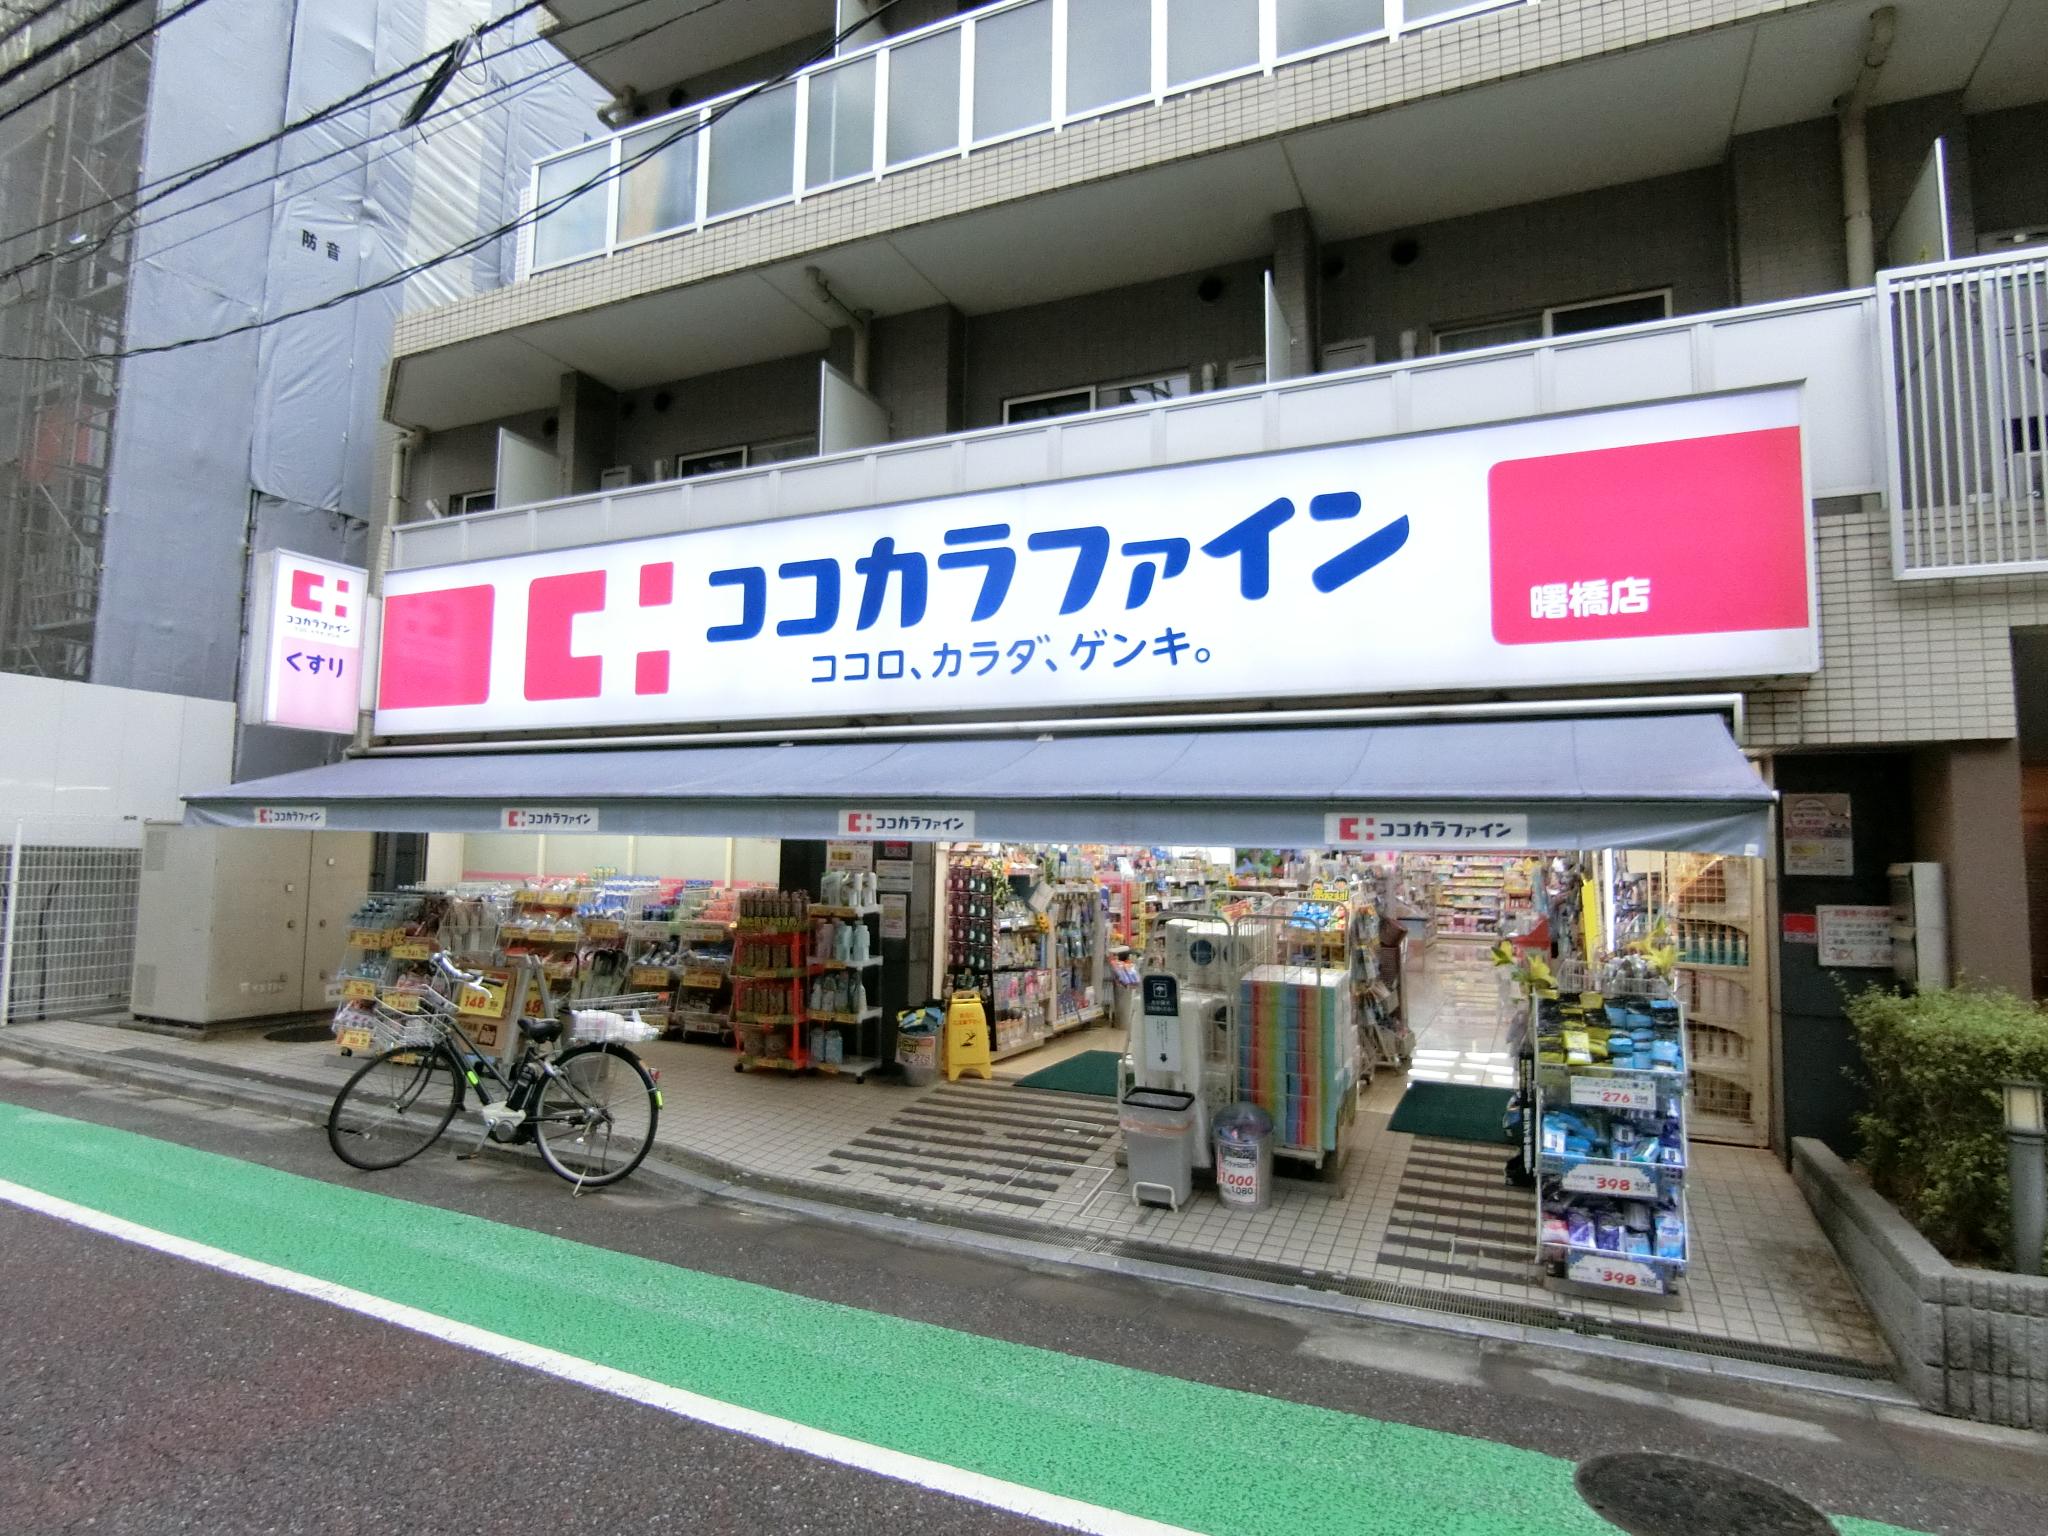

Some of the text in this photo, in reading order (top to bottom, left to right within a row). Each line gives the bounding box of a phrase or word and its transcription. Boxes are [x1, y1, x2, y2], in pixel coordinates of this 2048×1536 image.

[706, 491, 1410, 643] ココカラファイン
[1529, 576, 1651, 619] 曙橋店
[286, 615, 351, 633] ココカラファイン
[810, 627, 1212, 683] ココロ、カラダ、ゲンキ。
[286, 652, 344, 678] くすり
[274, 809, 321, 822] ココカラファイン
[528, 812, 592, 825] ココカラファイン
[875, 816, 964, 831] ココカラファイン
[1380, 821, 1511, 838] ココカラファイン
[1602, 1091, 1631, 1104] 276
[1596, 1177, 1630, 1191] 398
[1603, 1270, 1636, 1285] 398
